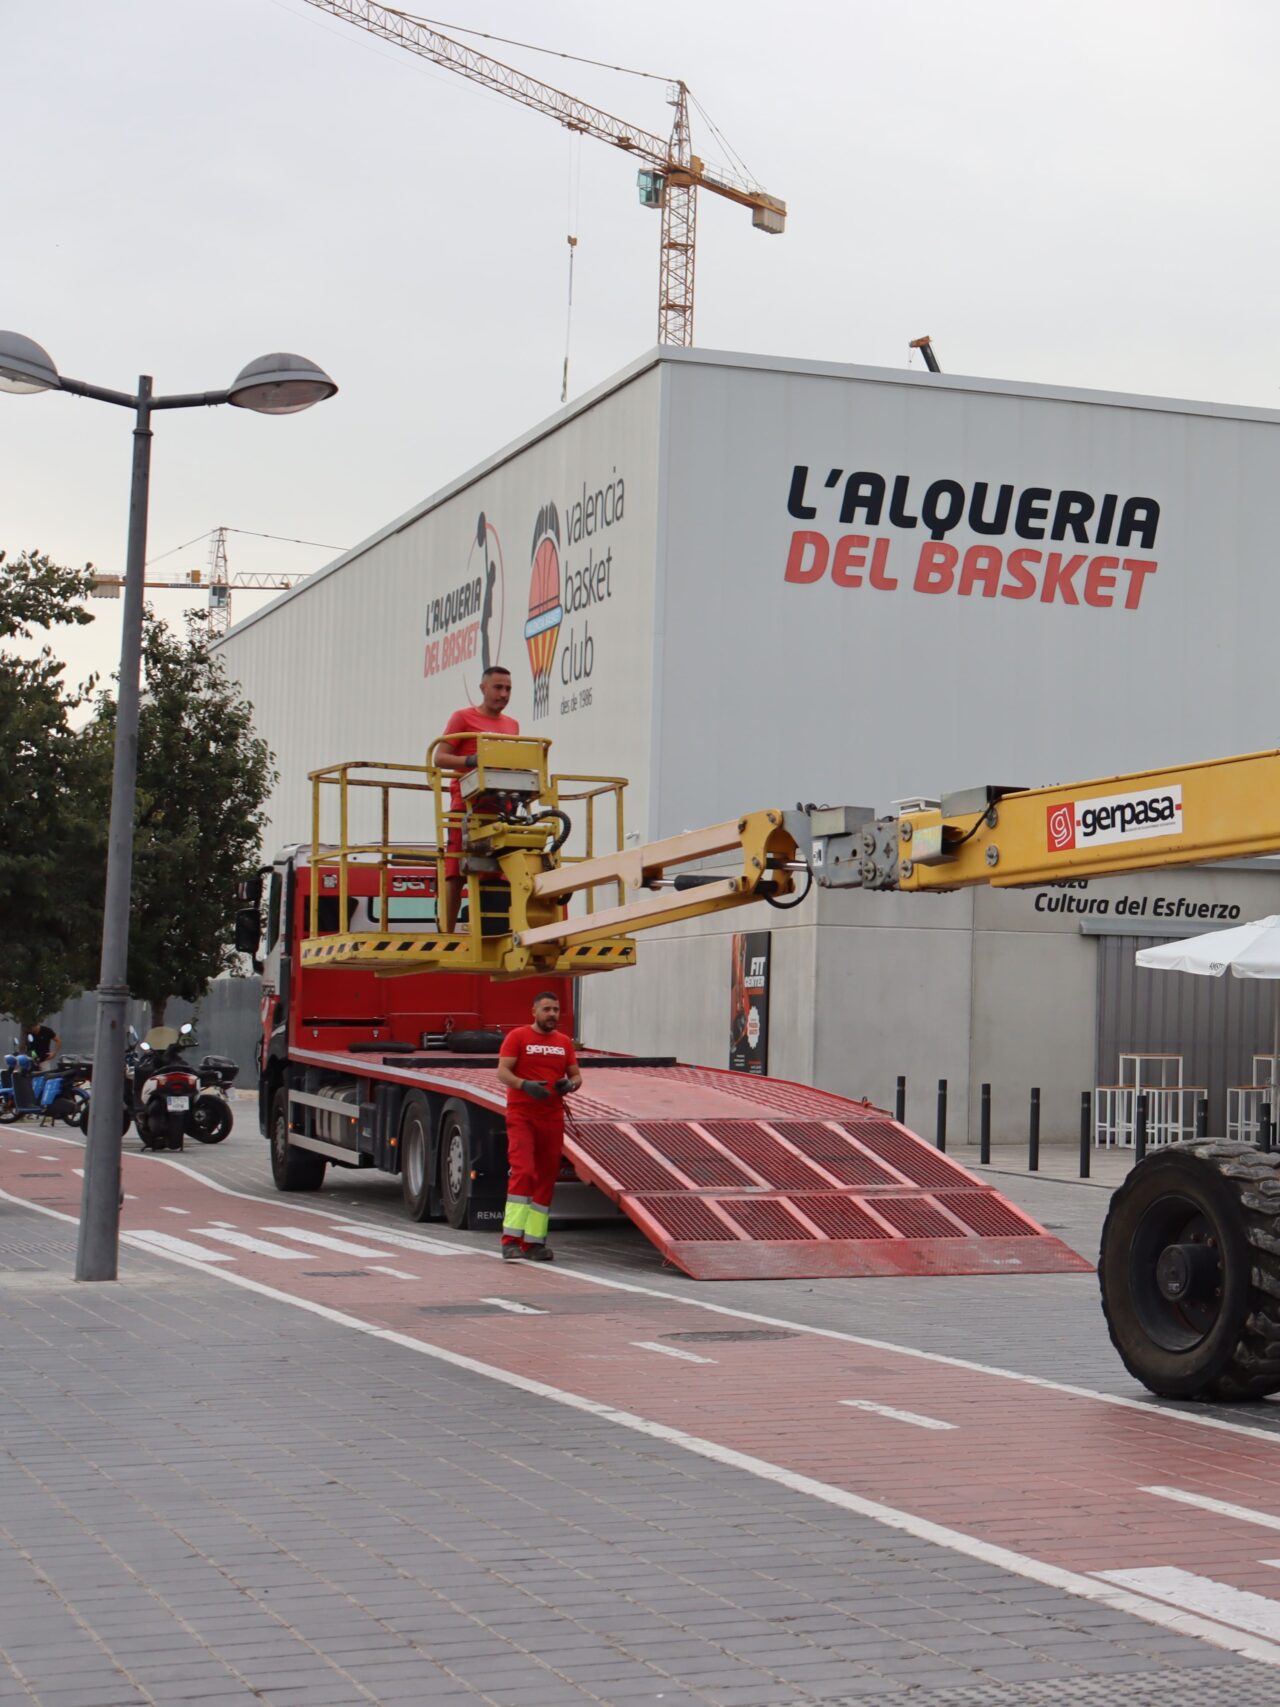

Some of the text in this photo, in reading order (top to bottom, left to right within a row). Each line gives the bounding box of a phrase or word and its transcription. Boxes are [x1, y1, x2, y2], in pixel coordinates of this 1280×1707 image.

[565, 466, 625, 546] valencia
[787, 465, 1160, 549] L'ALQUERIA
[564, 547, 613, 614] basket
[784, 530, 1158, 610] DEL BASKET
[425, 576, 482, 636] L'ALQUERIA
[424, 640, 440, 678] DEL
[441, 621, 480, 671] BASKET
[561, 620, 594, 685] club
[1082, 796, 1175, 837] gerpasa
[1034, 893, 1240, 919] Cultura del Esfuerzo
[750, 957, 766, 976] FIT
[526, 1044, 566, 1056] gerpasa
